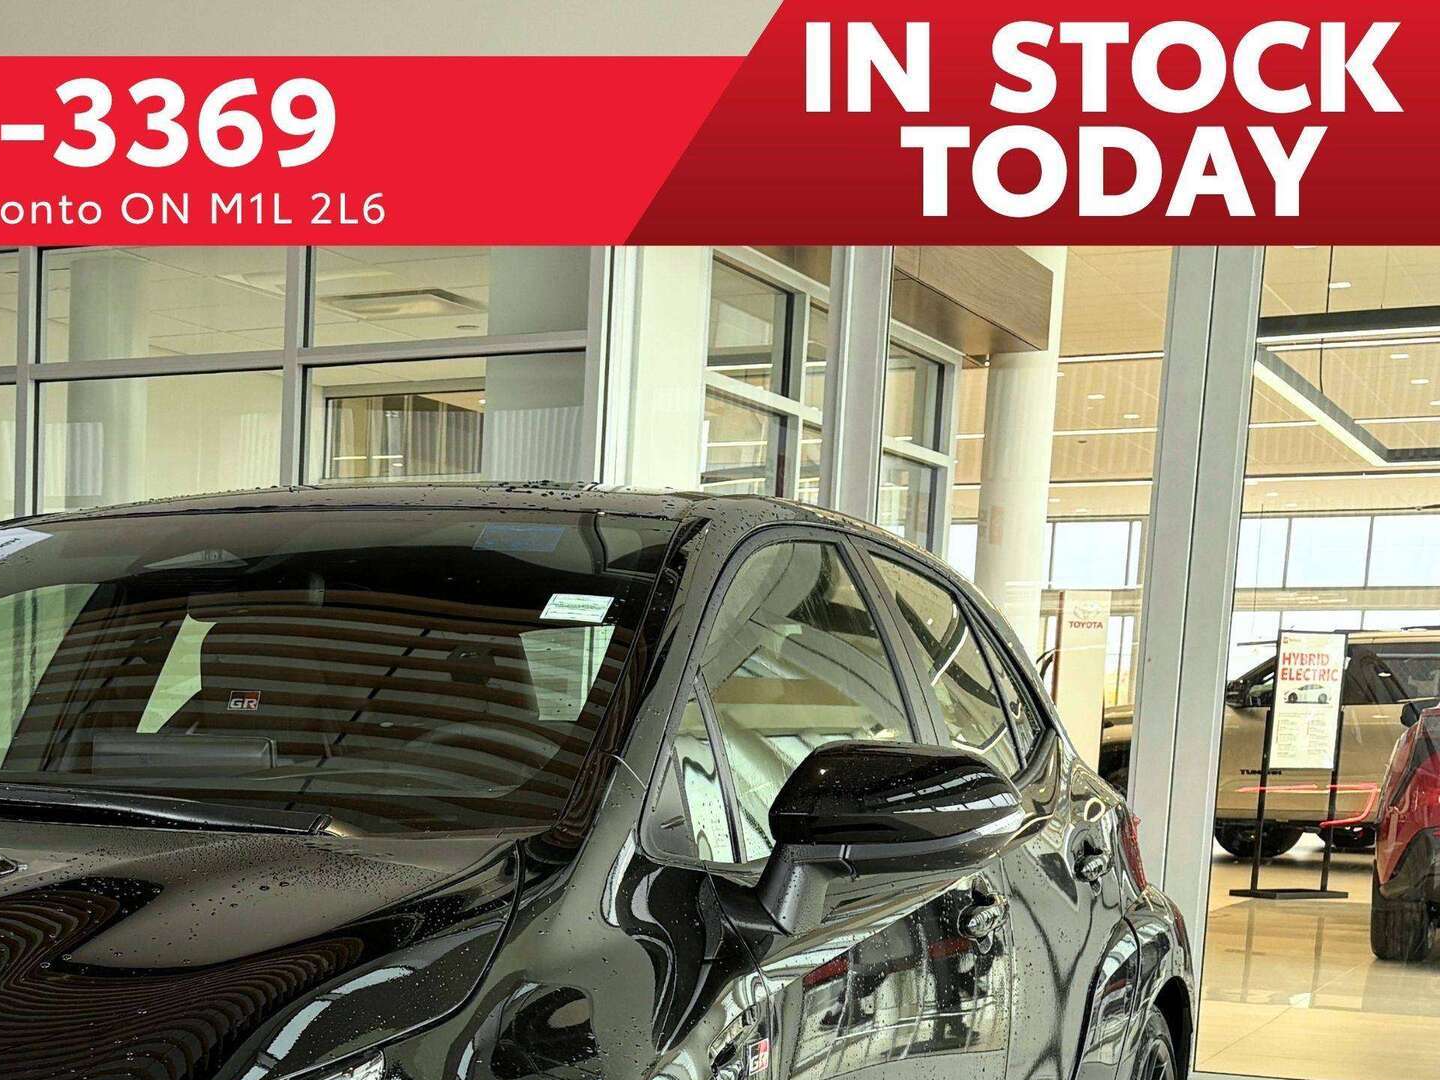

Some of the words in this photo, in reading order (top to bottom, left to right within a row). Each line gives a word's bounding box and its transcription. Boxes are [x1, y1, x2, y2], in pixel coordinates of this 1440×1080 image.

[1068, 621, 1103, 629] TOYOTA
[1282, 653, 1329, 666] HYBRID
[1280, 668, 1338, 681] ELECTRIC
